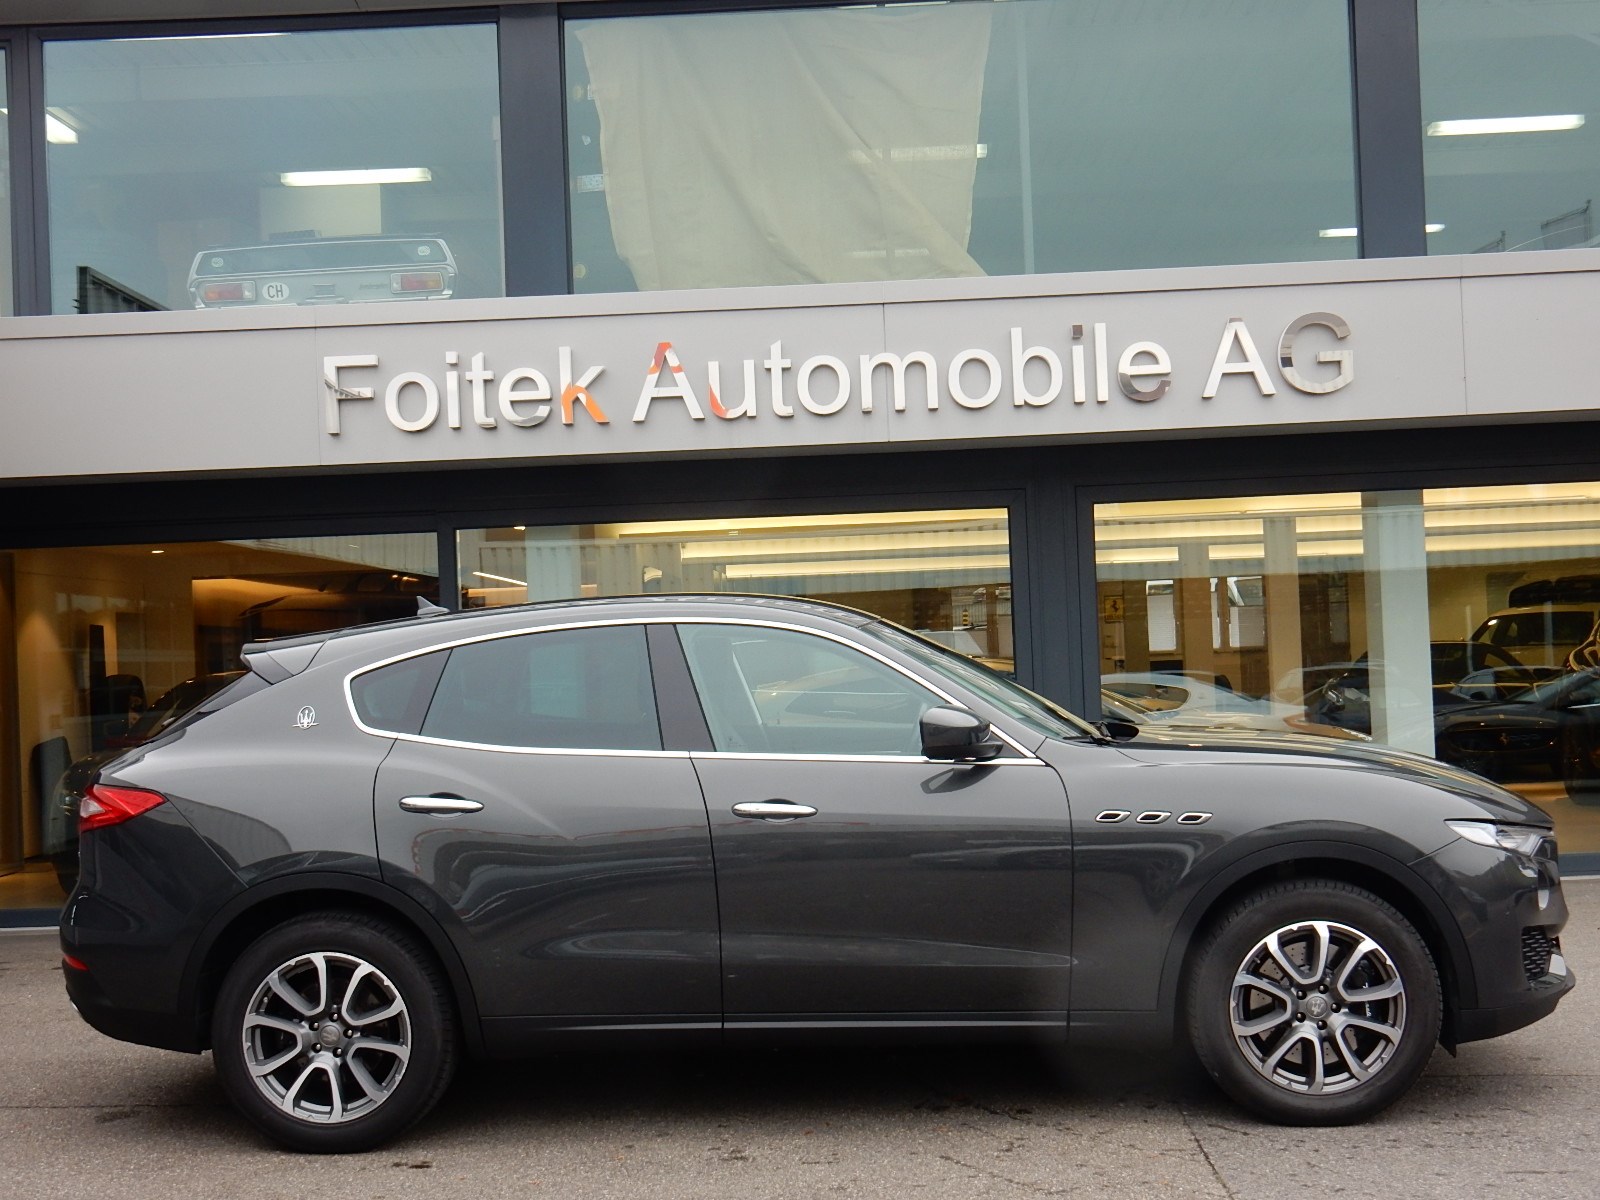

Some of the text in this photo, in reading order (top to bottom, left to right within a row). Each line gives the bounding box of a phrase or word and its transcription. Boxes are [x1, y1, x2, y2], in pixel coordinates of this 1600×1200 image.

[267, 284, 284, 298] CH
[323, 311, 1355, 435] Foitek Automobile AG
